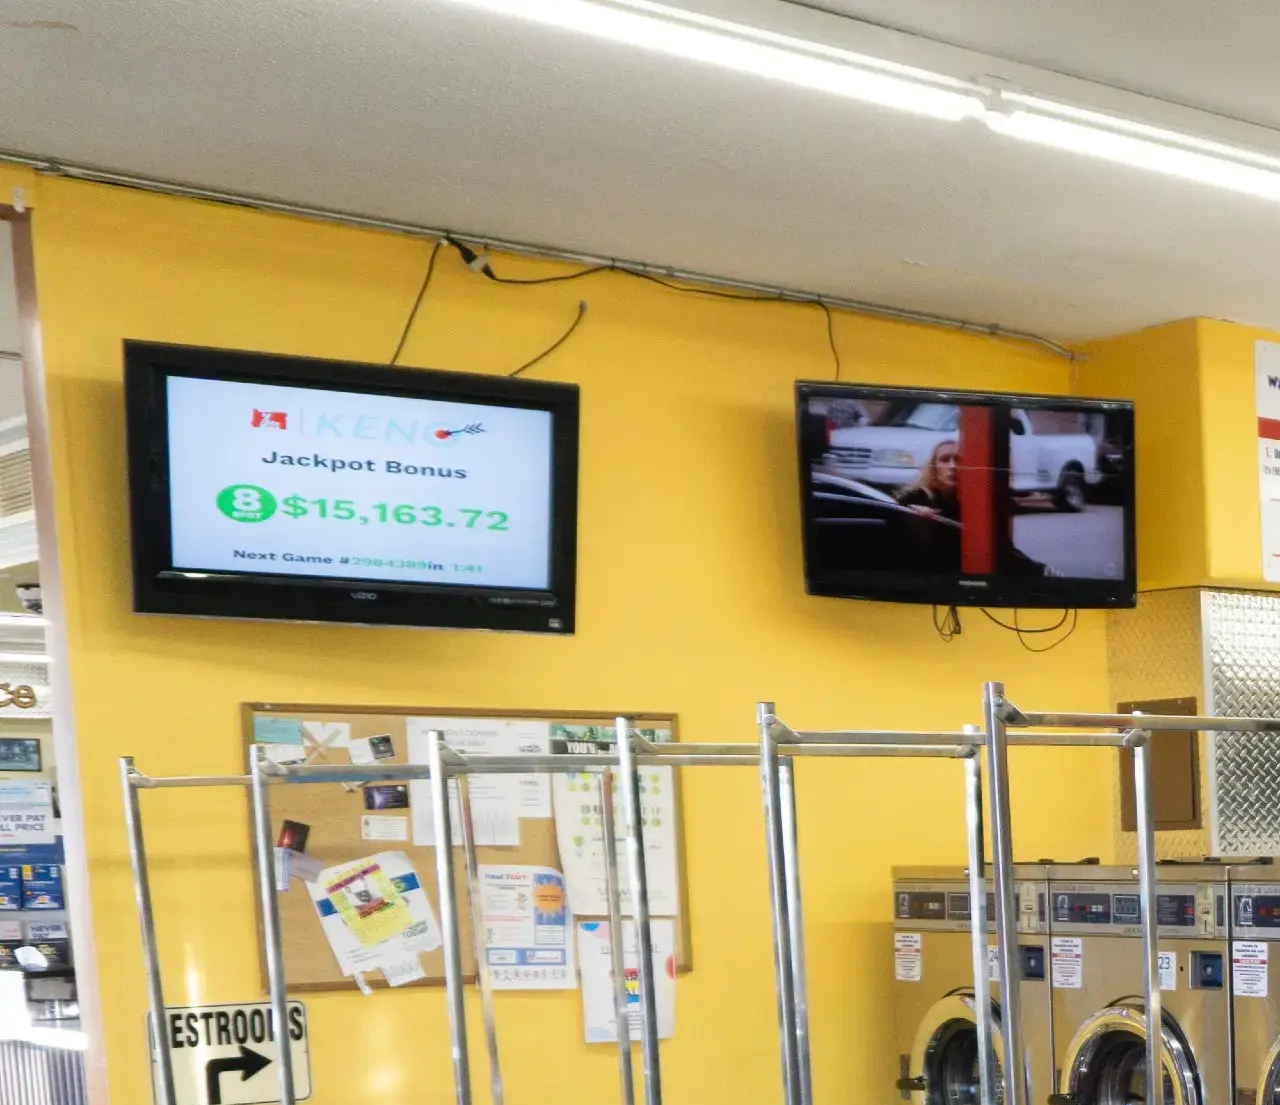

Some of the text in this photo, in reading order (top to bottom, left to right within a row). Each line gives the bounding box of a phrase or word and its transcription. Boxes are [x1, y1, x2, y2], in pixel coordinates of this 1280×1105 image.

[261, 450, 468, 479] Jackpot Bonus
[231, 486, 264, 512] 8
[282, 493, 509, 531] $15,163.72
[233, 549, 277, 562] Next
[282, 552, 334, 565] Game
[350, 591, 377, 600] VIZIO
[26, 814, 46, 822] PAY
[15, 823, 45, 831] PRICE
[1158, 956, 1170, 970] 23
[153, 1006, 304, 1049] ESTROOS
